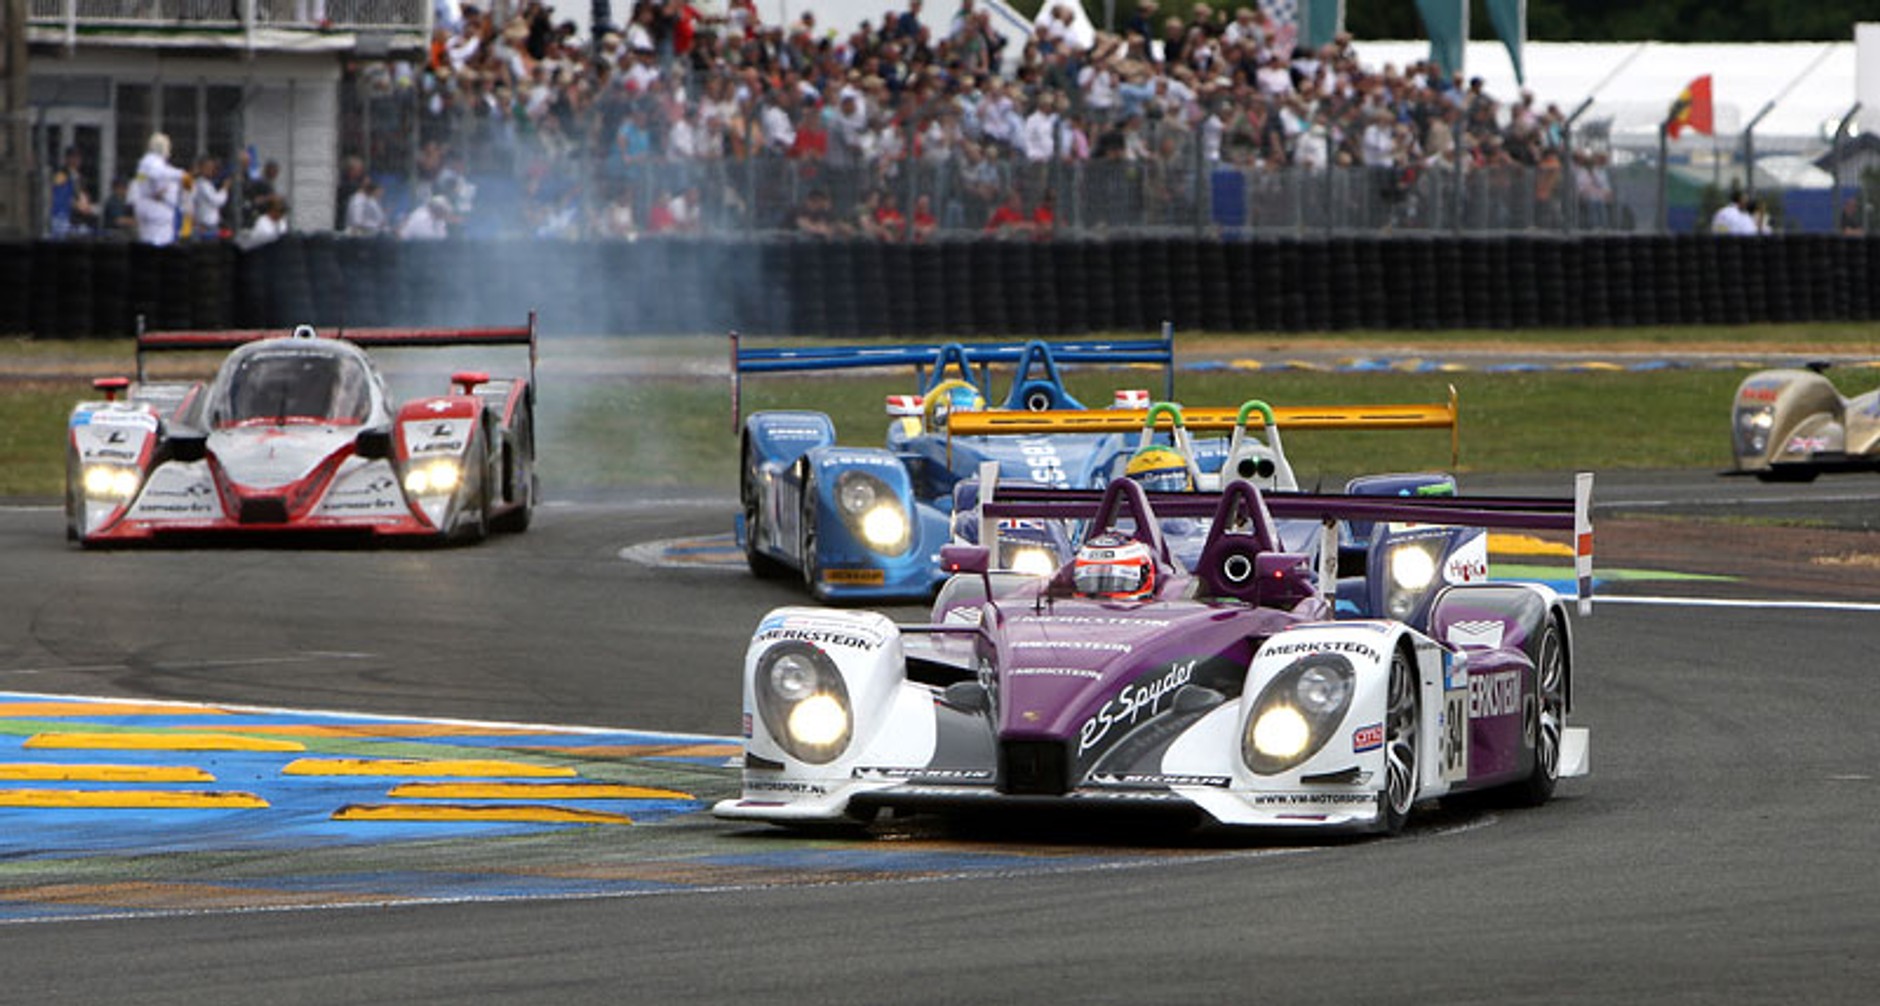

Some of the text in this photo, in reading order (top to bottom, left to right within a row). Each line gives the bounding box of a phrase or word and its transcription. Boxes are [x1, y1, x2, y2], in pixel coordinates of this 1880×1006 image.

[1078, 660, 1196, 756] RS Spyder
[1447, 698, 1463, 770] 34
[1124, 775, 1226, 785] MICHELIN
